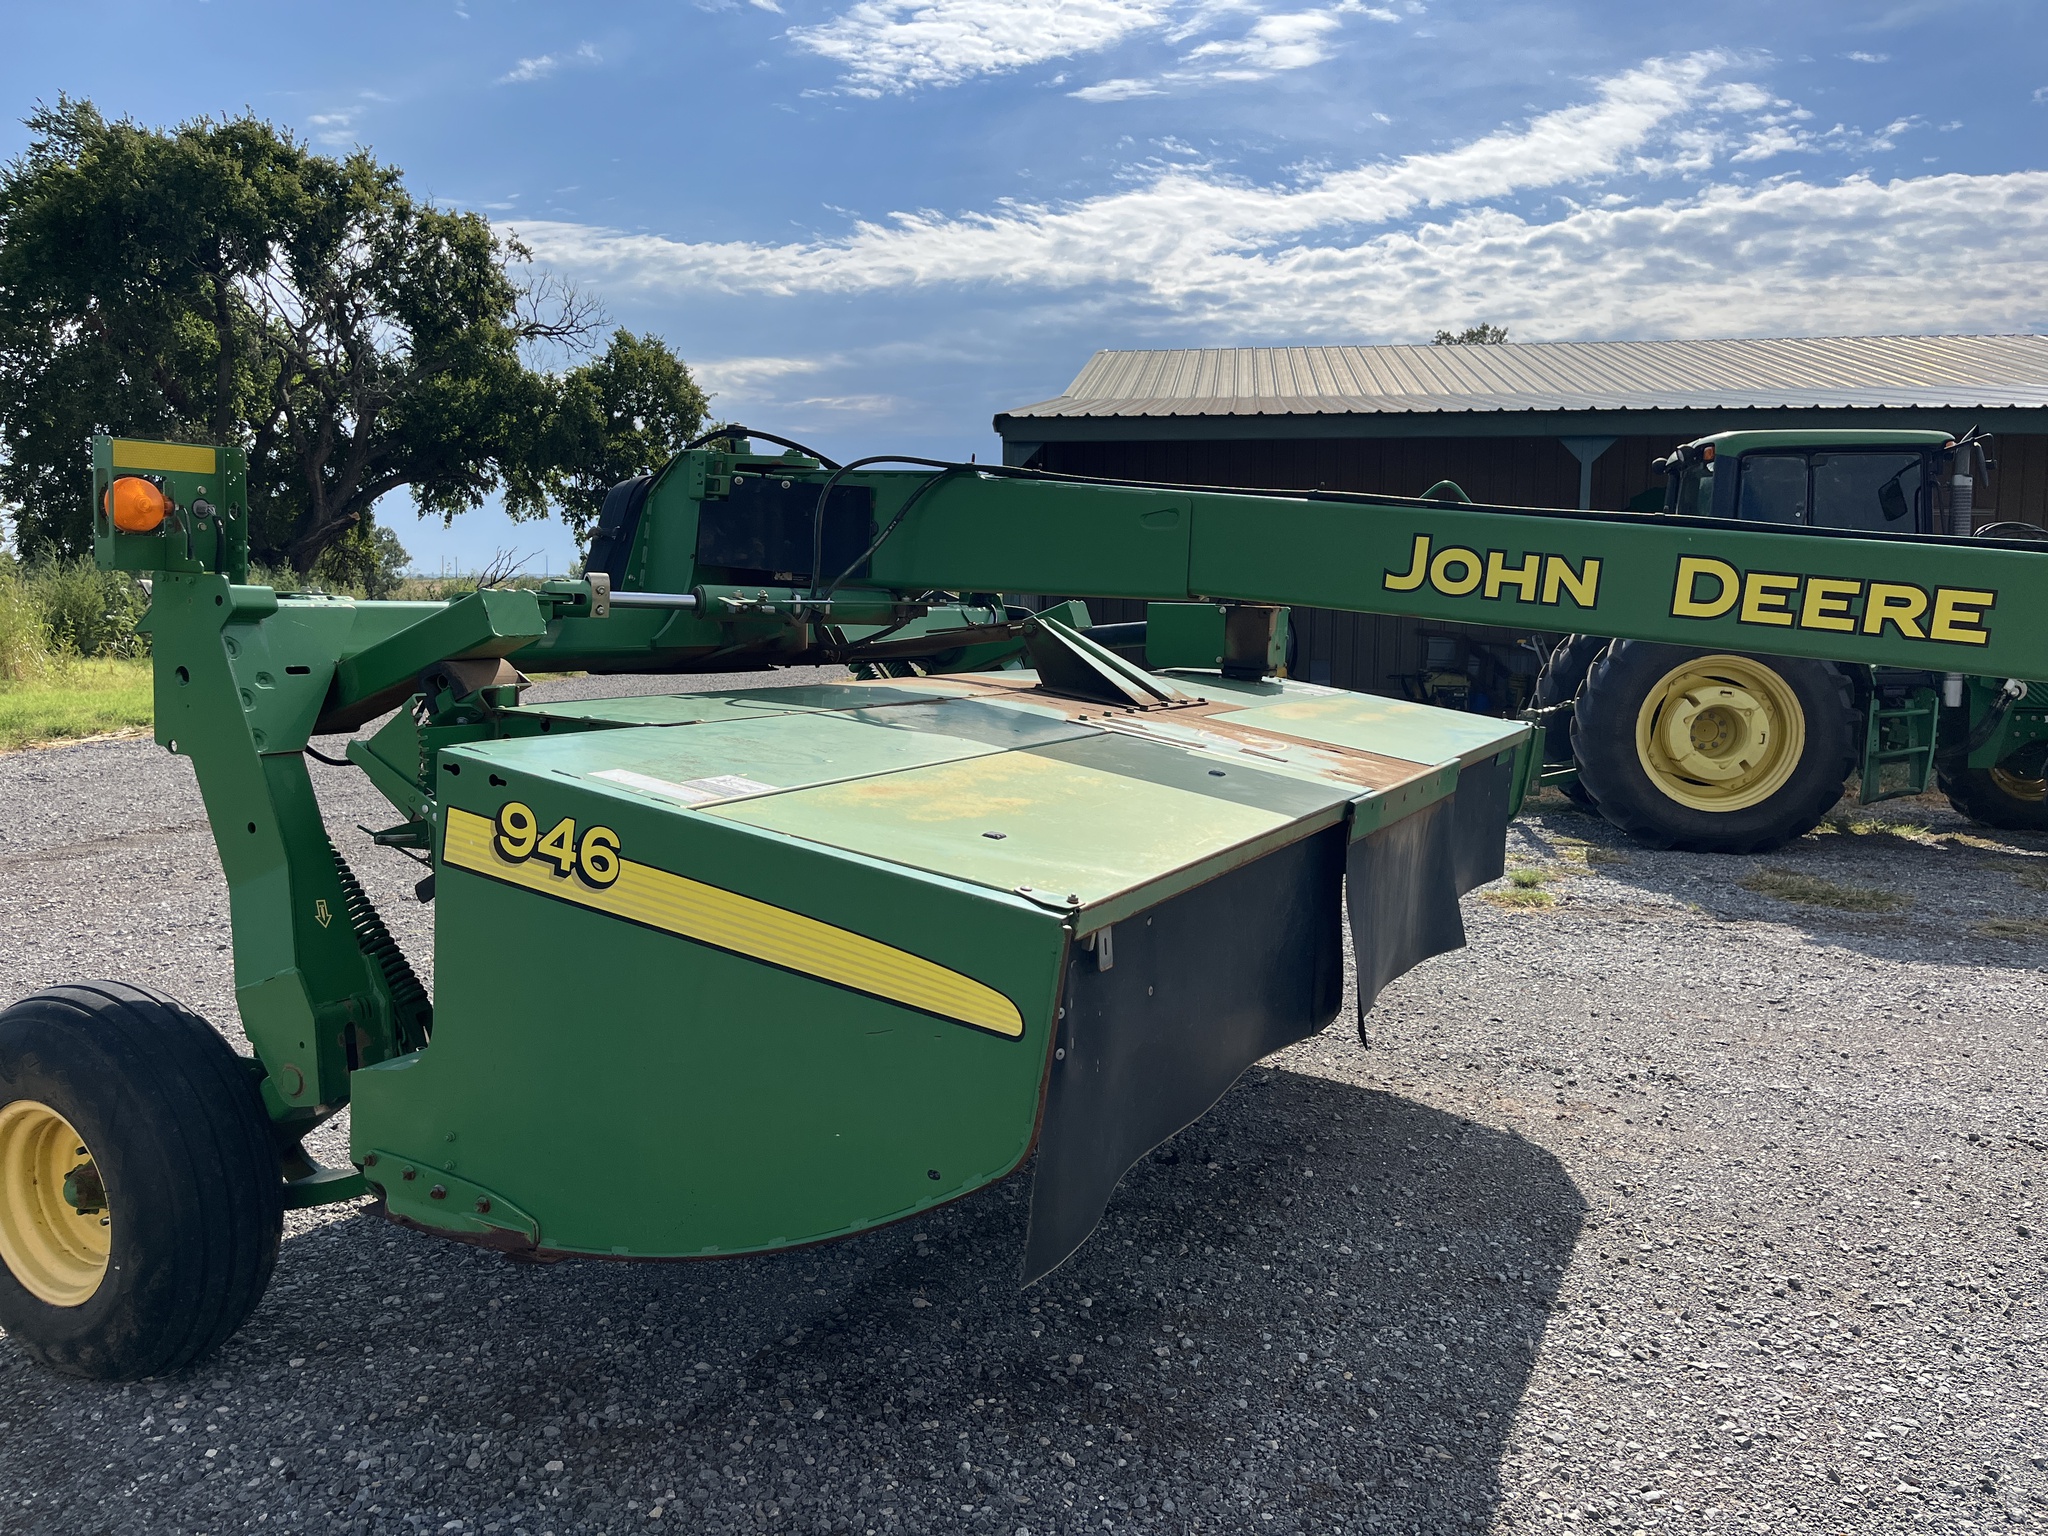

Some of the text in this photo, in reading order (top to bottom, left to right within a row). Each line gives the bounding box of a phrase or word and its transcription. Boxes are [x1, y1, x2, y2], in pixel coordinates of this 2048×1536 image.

[1384, 535, 1996, 645] JOHN DEERE
[496, 801, 621, 886] 946
